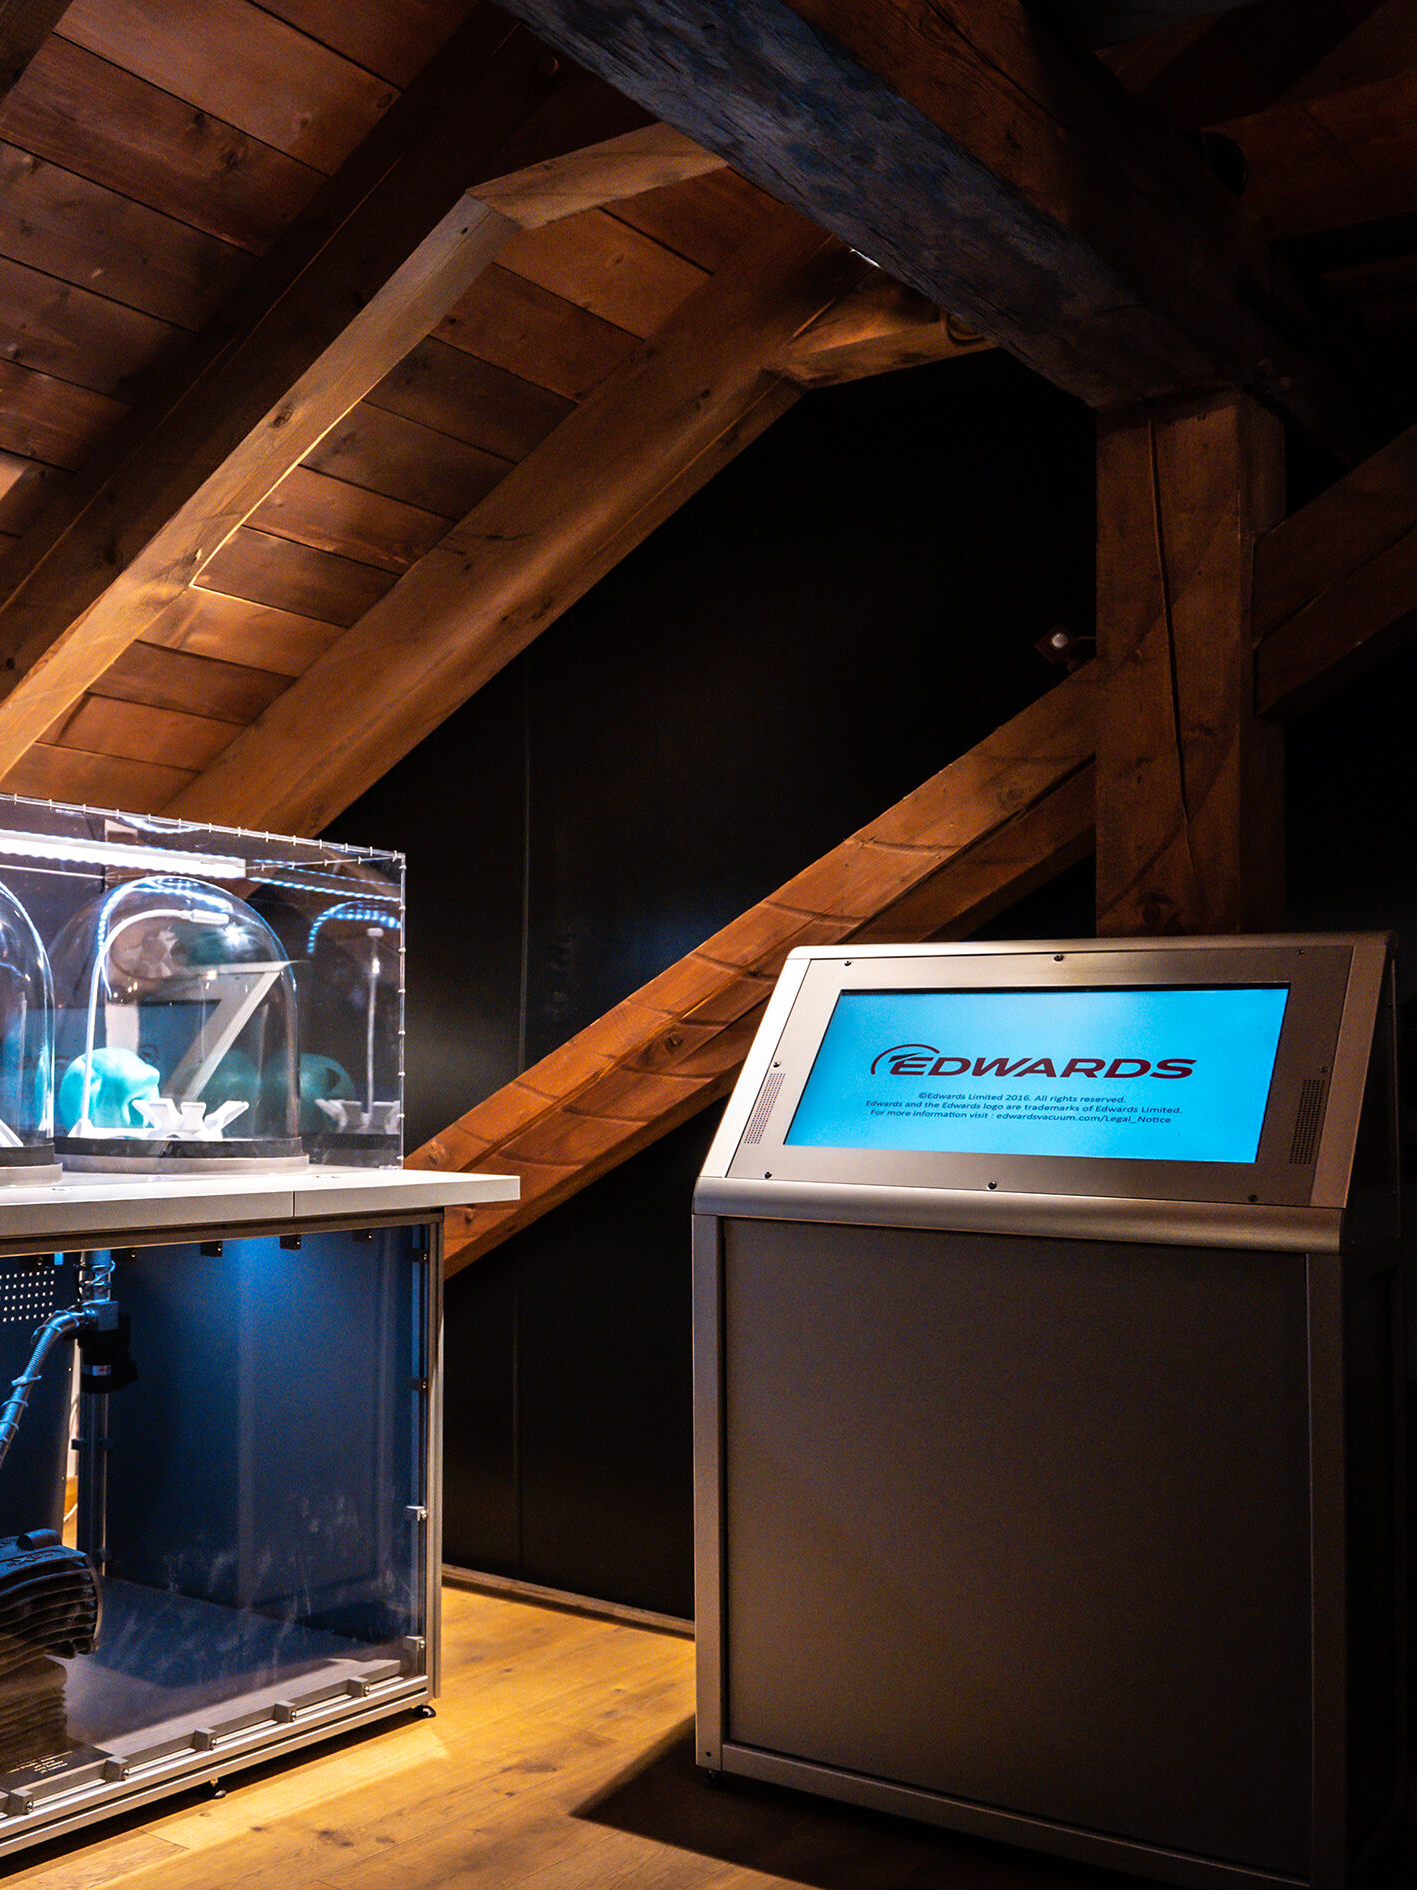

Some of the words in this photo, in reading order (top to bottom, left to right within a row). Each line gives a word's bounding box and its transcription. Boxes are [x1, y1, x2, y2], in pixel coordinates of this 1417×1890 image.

[889, 1056, 1198, 1080] EDWARDS
[968, 1093, 1003, 1101] Limited
[1050, 1095, 1078, 1103] rights
[983, 1103, 1003, 1111] logo
[1024, 1104, 1079, 1112] trademarks
[1095, 1105, 1138, 1113] Edwards
[1141, 1106, 1182, 1114] Limited.
[913, 1110, 967, 1118] information
[969, 1111, 988, 1119] visit
[996, 1112, 1172, 1124] edwardsvacuum.com/Legal_Notice
